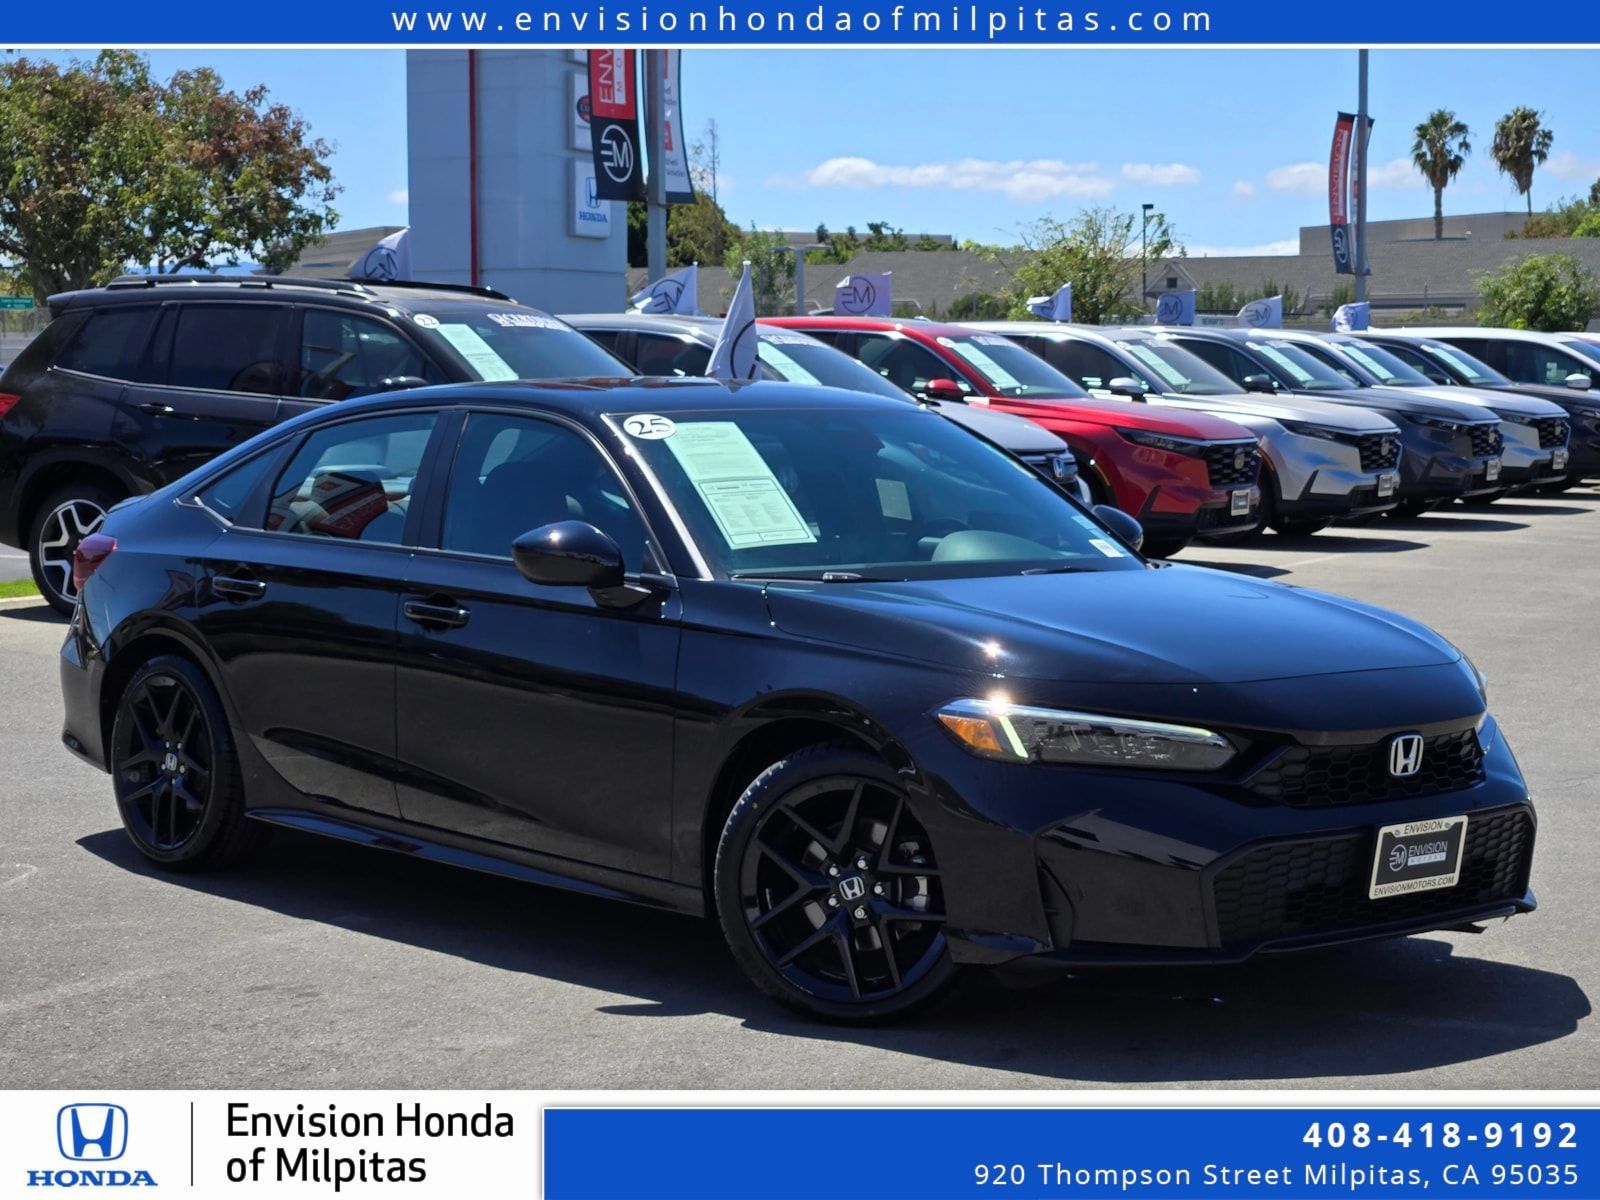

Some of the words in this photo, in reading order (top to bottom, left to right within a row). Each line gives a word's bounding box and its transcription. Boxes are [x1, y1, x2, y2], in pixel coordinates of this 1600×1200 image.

[579, 211, 608, 223] HONDA
[628, 417, 671, 435] 25
[1404, 821, 1443, 834] ENVISION
[1408, 841, 1448, 857] ENVISION
[1373, 876, 1455, 897] ENVISIONMOTORS.COM
